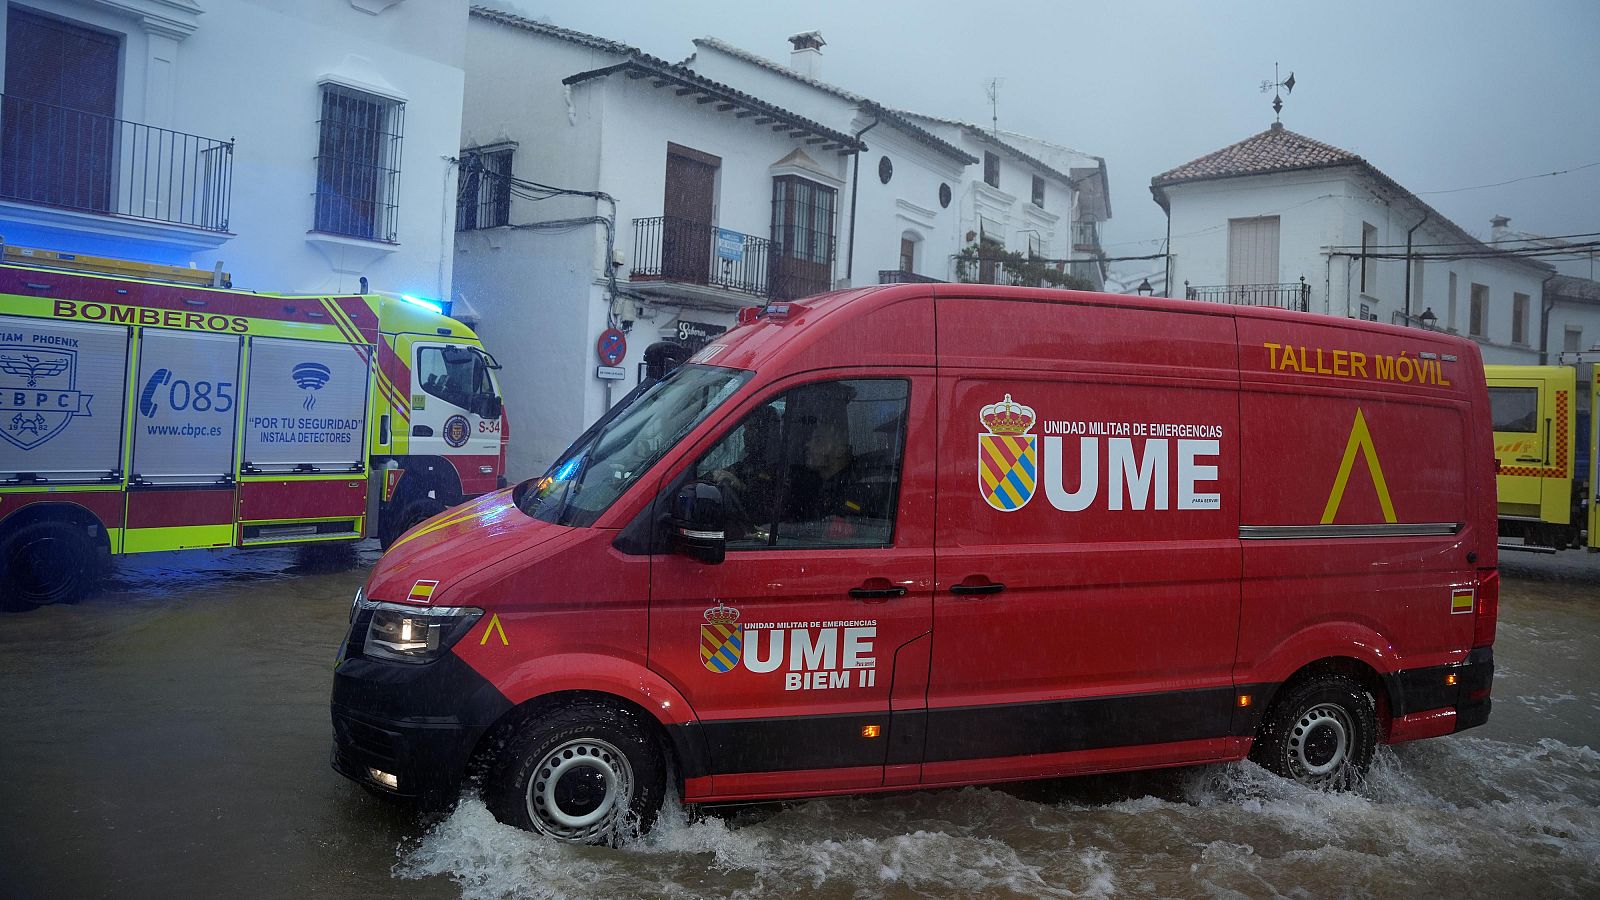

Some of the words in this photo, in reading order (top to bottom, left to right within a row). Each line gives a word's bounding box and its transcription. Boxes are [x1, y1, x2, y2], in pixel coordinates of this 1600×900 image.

[53, 299, 249, 333] BOMBEROS
[33, 334, 79, 347] PHOENIX
[1264, 343, 1368, 378] TALLER
[1375, 350, 1451, 386] MÓVIL
[0, 392, 69, 407] BPC
[169, 380, 233, 413] 085
[147, 422, 222, 438] www.cbpc.es
[281, 418, 295, 429] TU
[479, 421, 500, 433] S-34
[1044, 421, 1086, 435] UNIDAD
[1088, 422, 1131, 436] MILITAR
[1133, 423, 1147, 436] DE
[1150, 423, 1223, 438] EMERGENCIAS
[260, 431, 296, 443] INSTALA
[298, 432, 351, 443] DETECTORES
[1044, 436, 1221, 512] UME
[777, 621, 808, 629] MILITAR
[822, 619, 877, 628] EMERGENCIAS
[743, 627, 877, 673] UME
[785, 671, 850, 691] BIEM
[859, 670, 876, 688] II
